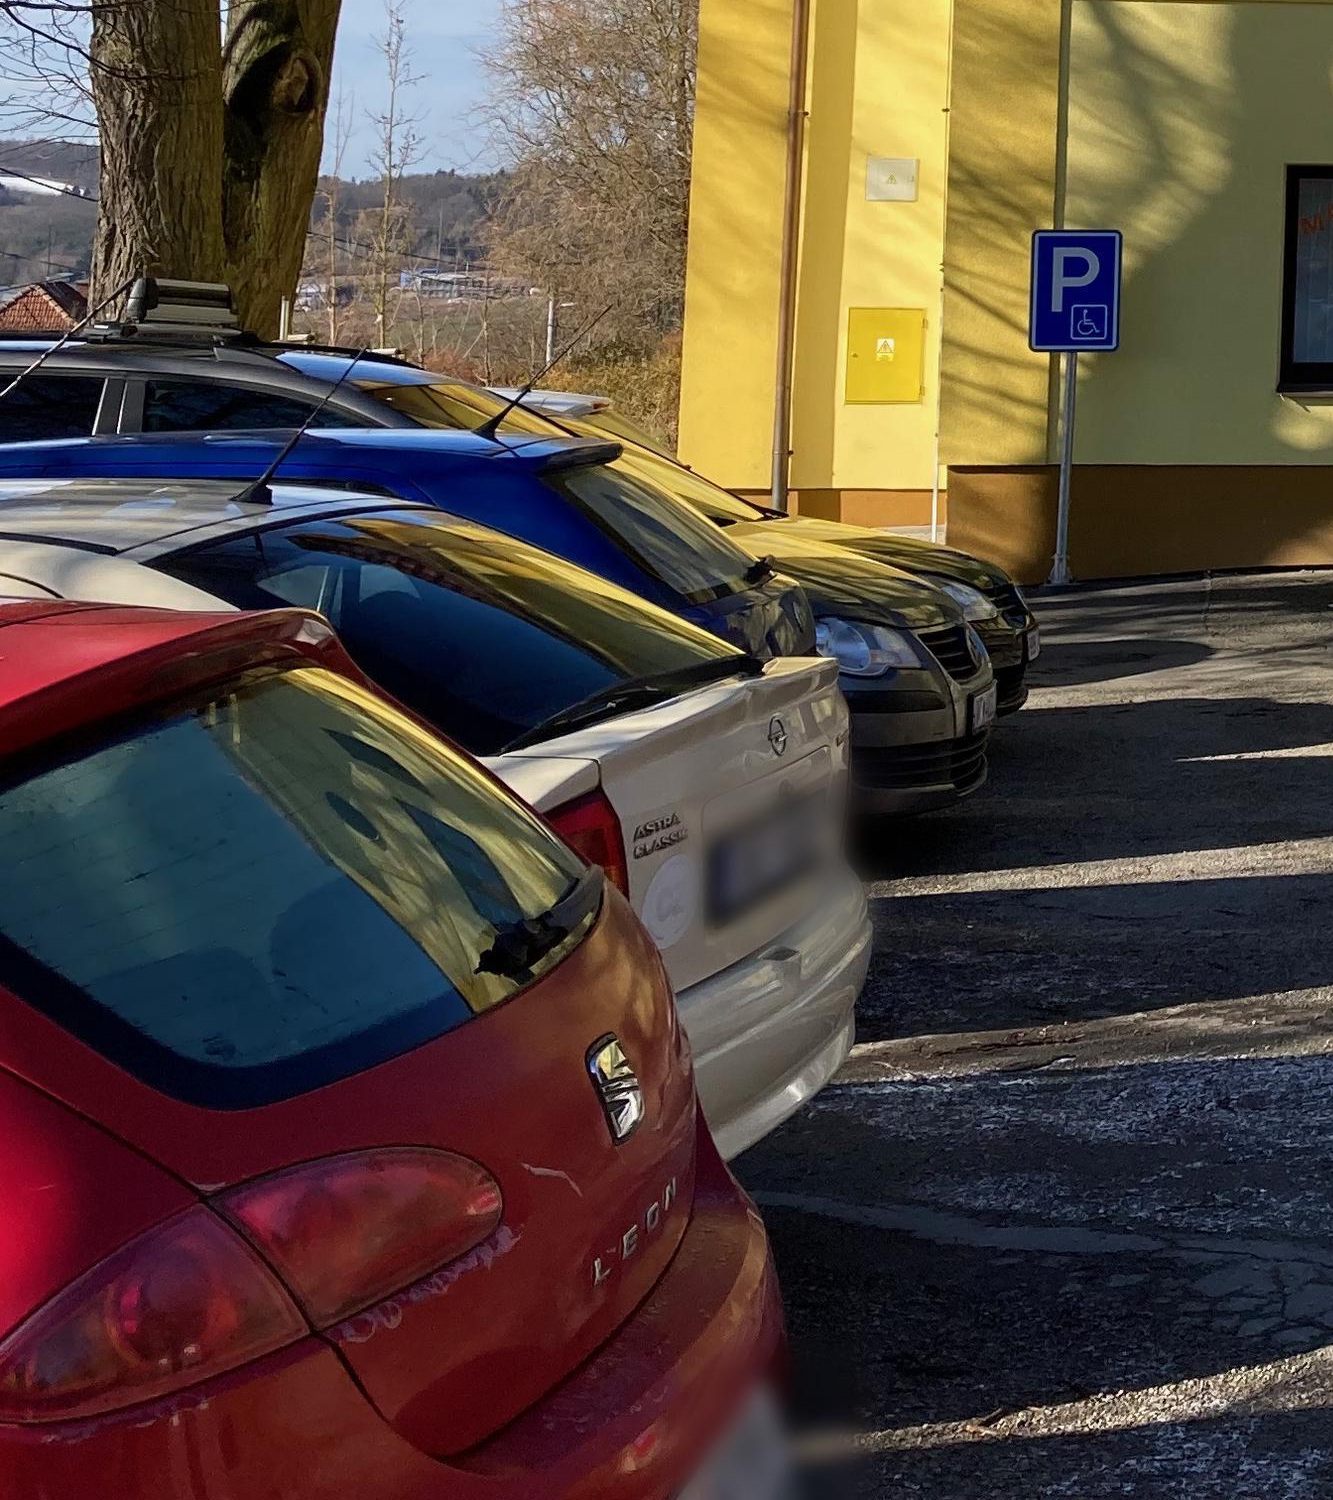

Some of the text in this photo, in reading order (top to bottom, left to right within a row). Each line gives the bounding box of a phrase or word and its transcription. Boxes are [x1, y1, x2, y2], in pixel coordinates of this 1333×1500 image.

[1051, 247, 1100, 312] P
[633, 811, 681, 842] ASTRA
[592, 1176, 677, 1288] LEON
